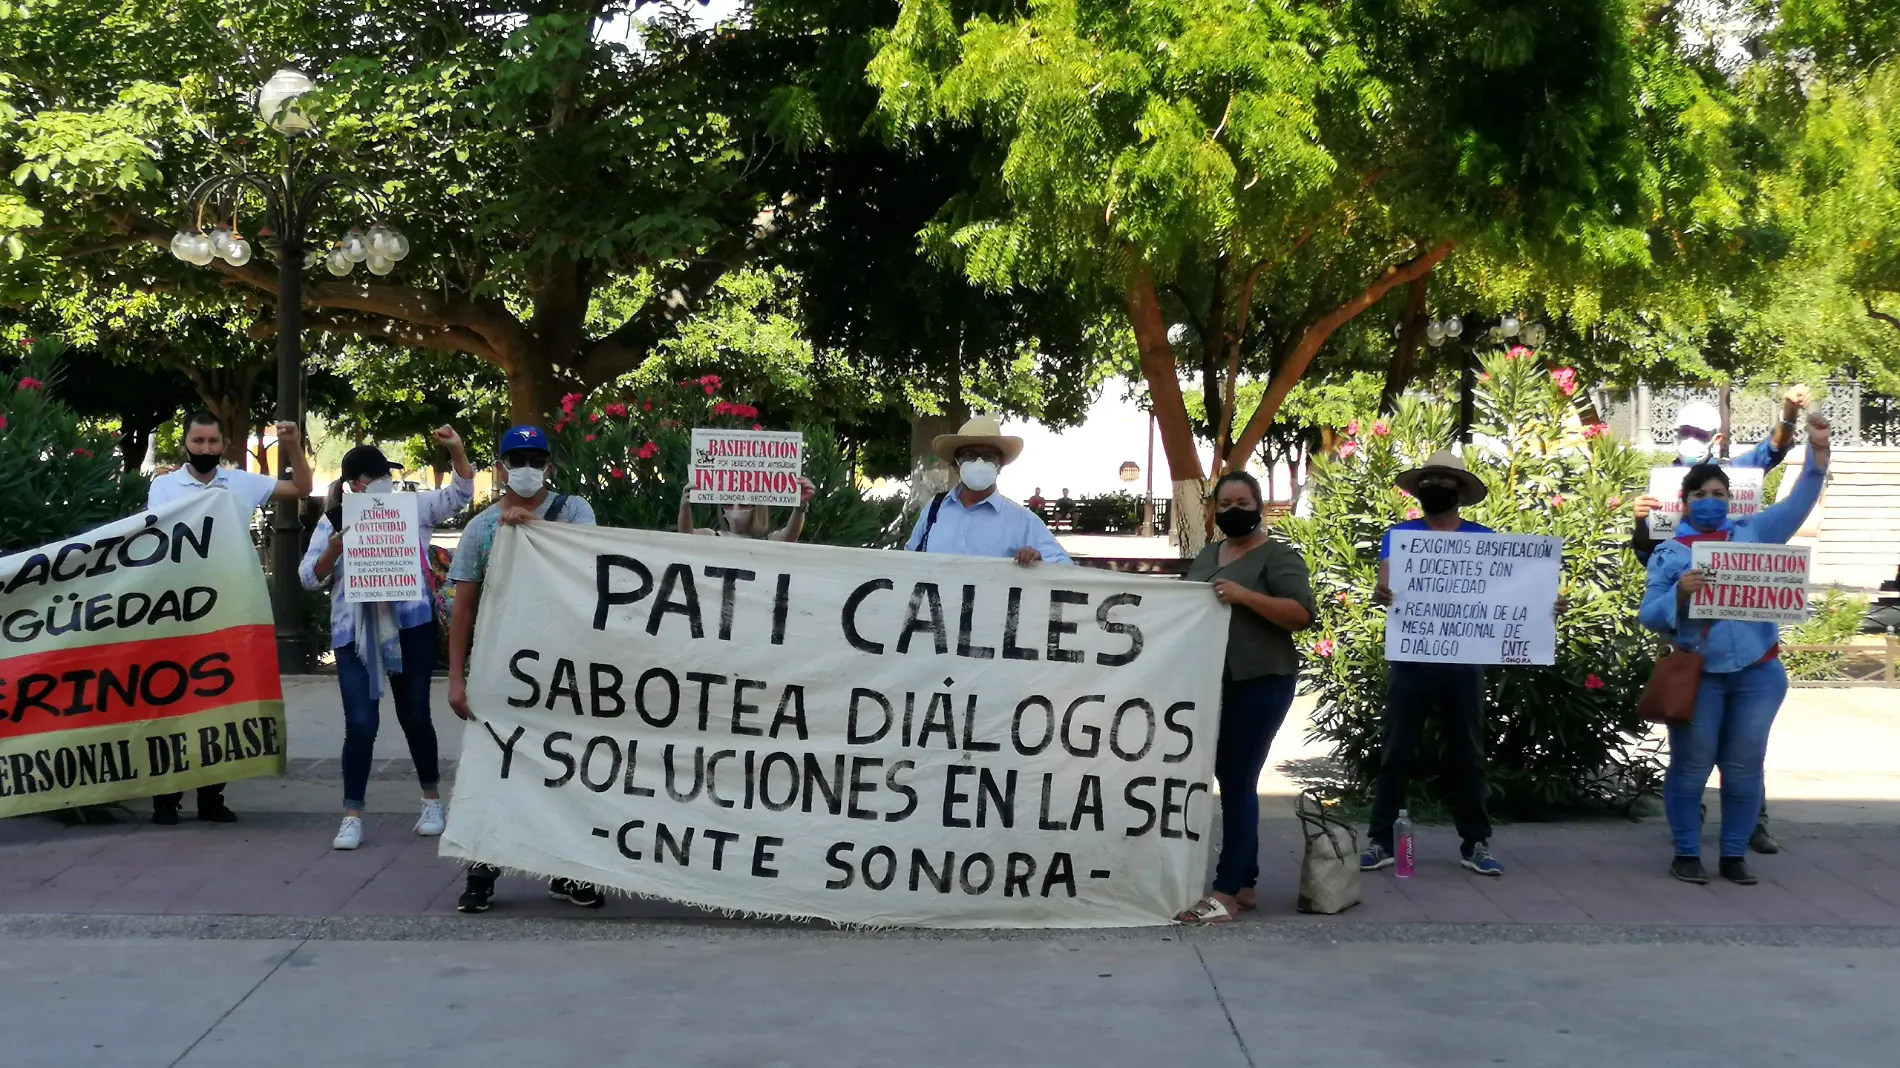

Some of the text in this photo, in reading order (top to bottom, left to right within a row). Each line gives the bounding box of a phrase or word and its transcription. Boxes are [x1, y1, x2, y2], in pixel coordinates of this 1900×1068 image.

[708, 438, 798, 459] BASIFICACIÓN
[731, 460, 756, 468] DERECHOS
[758, 460, 765, 468] DE
[695, 468, 798, 494] INTERINOS
[750, 494, 777, 503] SECCIÓN
[360, 508, 400, 520] ¡EXIGIMOS
[354, 522, 407, 532] CONTINUIDAD
[358, 534, 405, 545] A NUESTROS
[1410, 538, 1553, 559] EXIGIMOS BASIFICACIÓN
[0, 514, 214, 595] ACIÓN
[347, 547, 416, 559] NOMBRAMIENTOS!
[1710, 550, 1806, 573] BASIFICACIÓN
[1404, 558, 1513, 578] A DOCENTES CON
[350, 573, 417, 588] BASIFICACIÓN
[1734, 574, 1761, 583] DERECHOS
[1763, 575, 1770, 583] DE
[1694, 583, 1805, 610] INTERINOS
[0, 586, 218, 642] GÜEDAD
[592, 554, 1144, 668] PATI CALLES
[1404, 602, 1528, 621] REANUDACIÓN DE LA
[1720, 609, 1747, 617] SONORA
[1401, 620, 1524, 640] MESA NACIONAL DE
[1400, 637, 1530, 657] DIÁLOGO CNTE
[507, 648, 1196, 764] SABOTEA DIÁLOGOS
[146, 732, 190, 778] DE
[198, 716, 281, 767] BASE
[484, 721, 1208, 842] Y SOLUCIONES EN LA SEC
